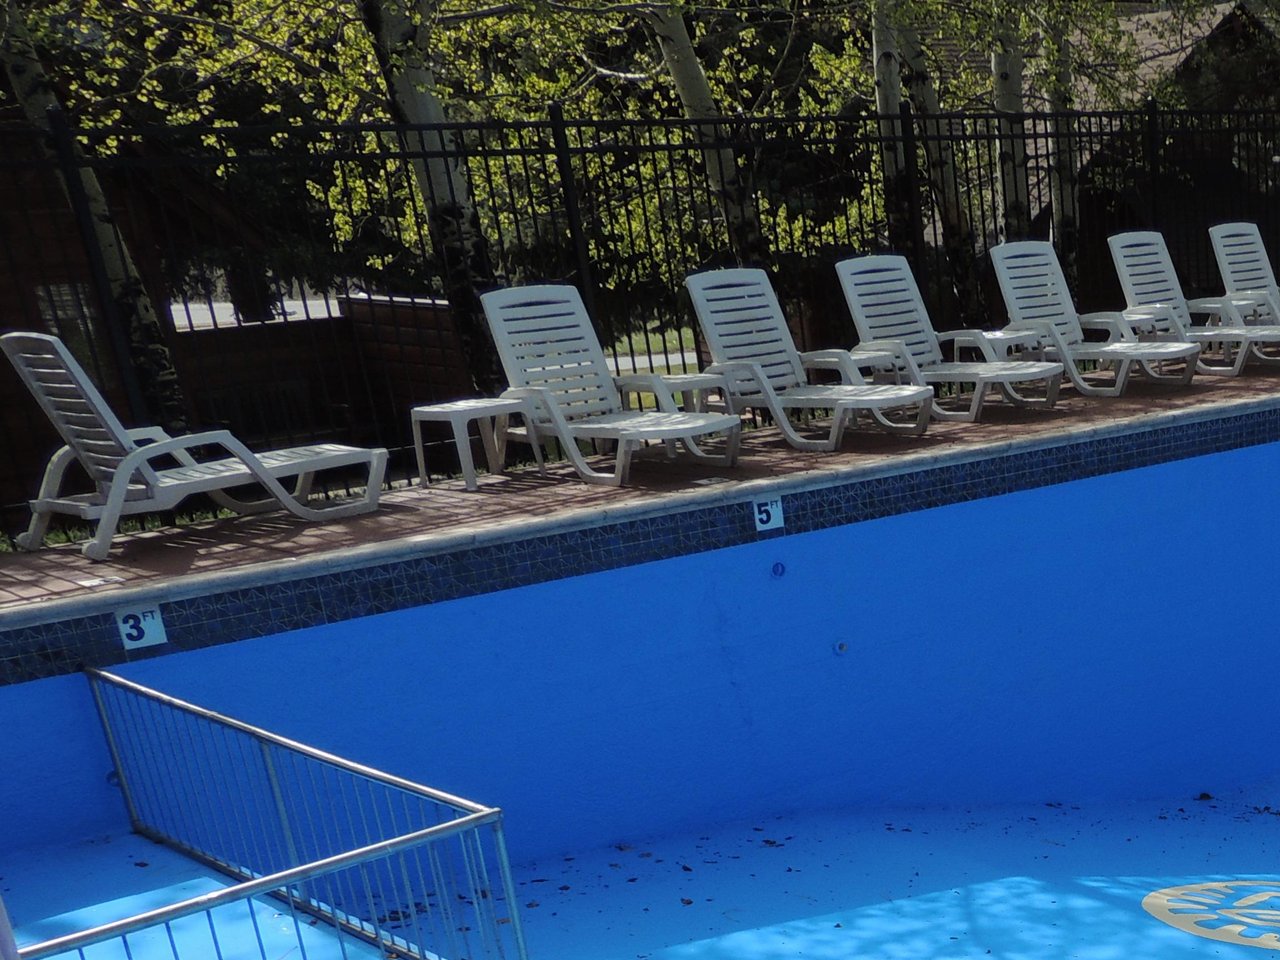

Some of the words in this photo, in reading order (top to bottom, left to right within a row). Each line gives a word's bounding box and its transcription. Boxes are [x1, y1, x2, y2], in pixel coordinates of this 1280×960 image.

[757, 502, 771, 524] 5
[770, 500, 778, 508] FT
[123, 614, 144, 641] 3
[142, 610, 155, 621] FT
